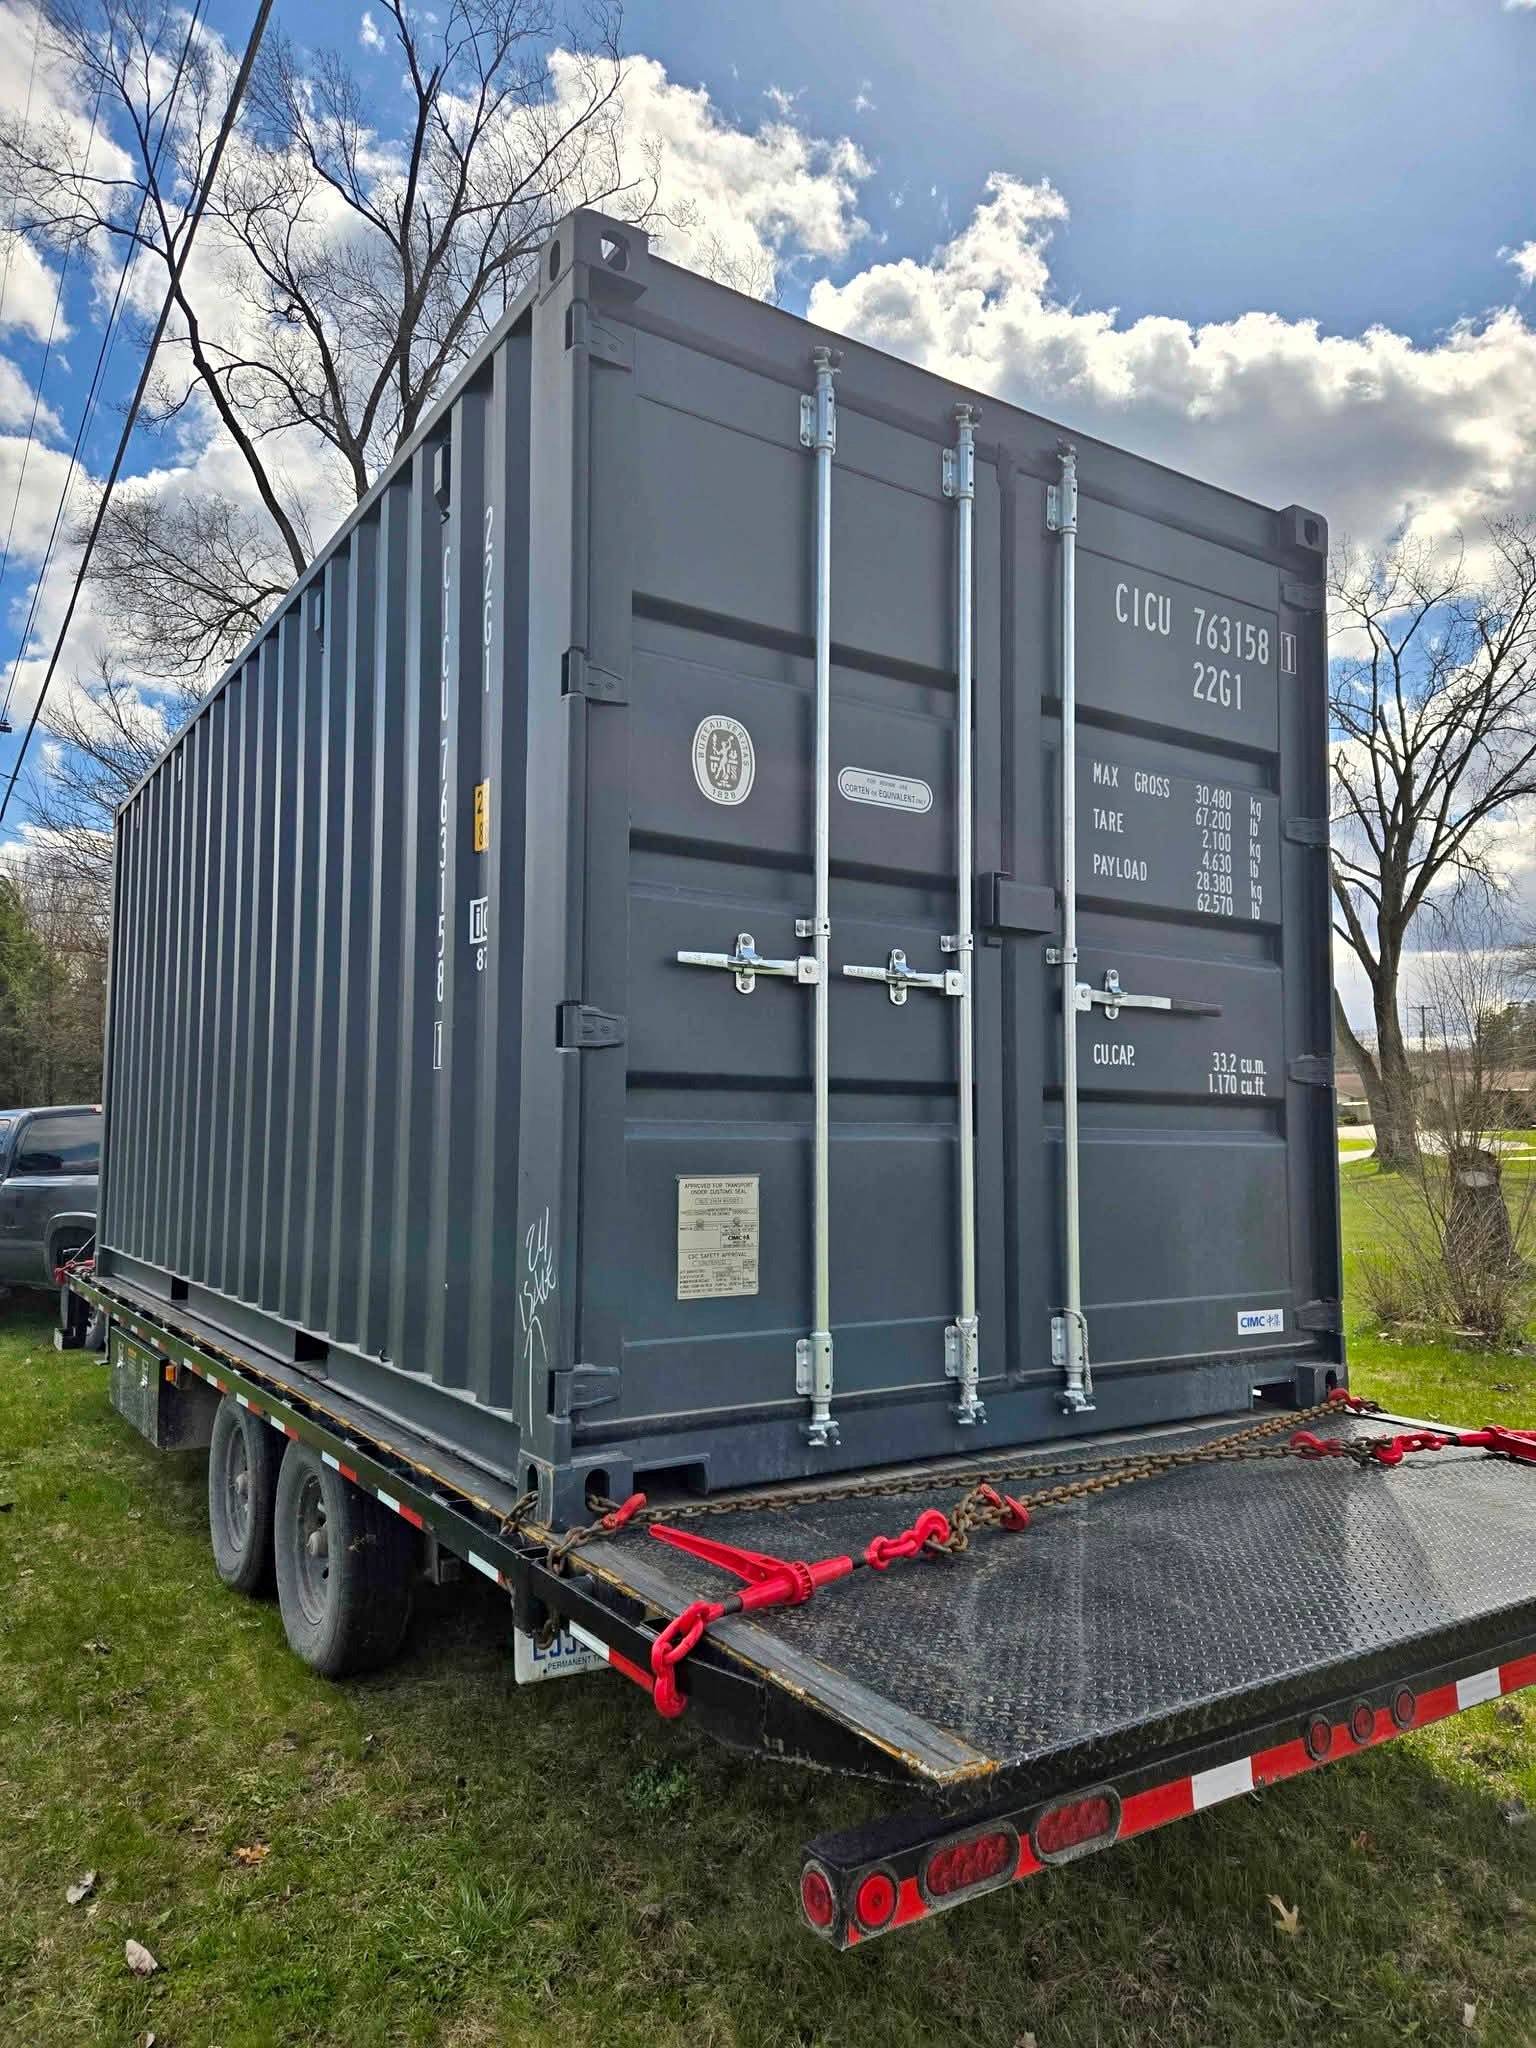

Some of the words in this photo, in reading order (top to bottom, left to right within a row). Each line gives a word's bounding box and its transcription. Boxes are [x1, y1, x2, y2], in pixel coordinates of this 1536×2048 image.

[483, 505, 494, 692] 22G1
[441, 546, 451, 722] CICU
[1115, 583, 1171, 636] CICU
[1194, 607, 1269, 664] 763158
[1193, 662, 1242, 710] 22G1
[698, 721, 722, 758] BUREAU
[726, 721, 749, 767] VERITAS
[711, 789, 736, 799] 1828
[844, 783, 870, 796] CORTEN
[879, 789, 915, 804] EQUIVALENT
[1093, 762, 1119, 787] MAX
[1134, 771, 1170, 798] GROSS
[1195, 784, 1232, 810] 30.480
[1250, 796, 1262, 818] kg
[1093, 807, 1124, 833] TARE
[1202, 830, 1231, 853] 2.100
[1250, 839, 1261, 863] kg
[1195, 807, 1231, 832] 67.200
[1250, 818, 1258, 837] lb
[436, 737, 448, 1003] 763158
[1093, 854, 1148, 881] PAYLOAD
[1196, 871, 1232, 894] 28.380
[1250, 880, 1262, 904] kg
[1202, 852, 1231, 874] 4.630
[1250, 860, 1259, 879] lb
[1197, 894, 1233, 916] 62.570
[1251, 902, 1260, 920] lb
[1093, 1043, 1136, 1067] CU.CAP.
[1213, 1052, 1237, 1073] 33.2
[1240, 1057, 1267, 1075] cu.m.
[1208, 1073, 1237, 1095] 1.170
[1240, 1076, 1267, 1097] cu.ft.
[1240, 1315, 1265, 1328] CIMC
[547, 1655, 591, 1670] PERMANENT
